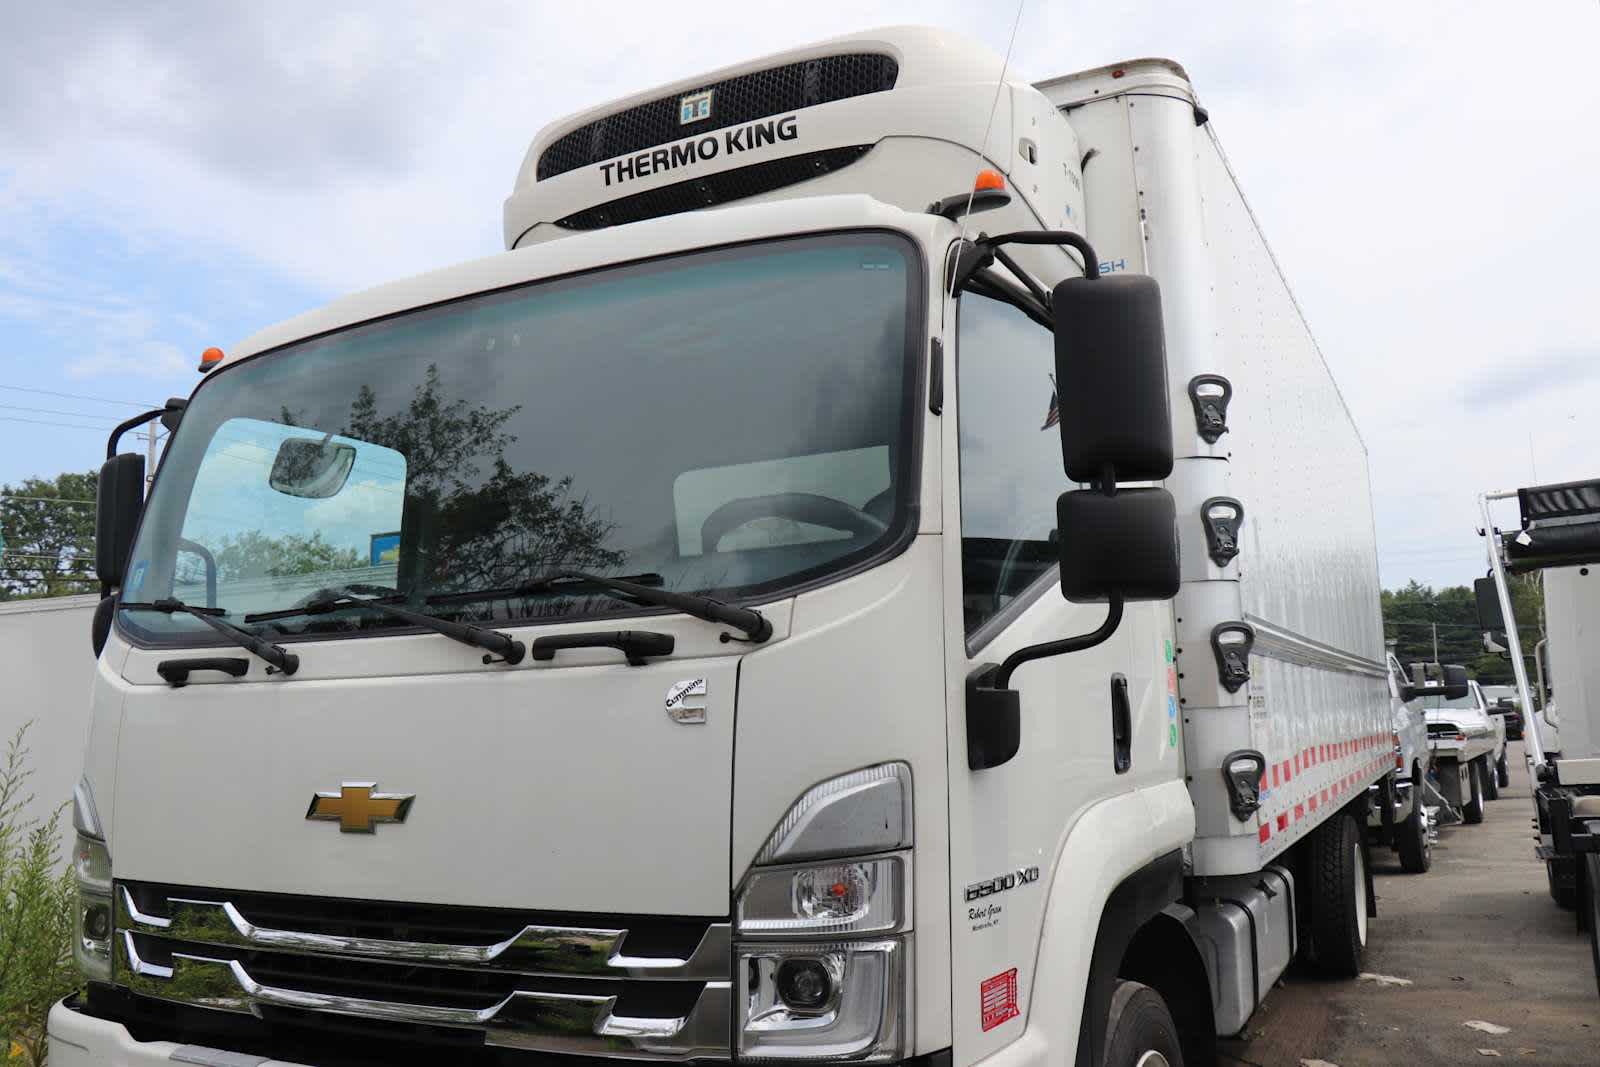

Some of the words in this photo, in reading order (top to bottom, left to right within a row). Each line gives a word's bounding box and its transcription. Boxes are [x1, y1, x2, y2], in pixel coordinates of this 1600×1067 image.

[599, 136, 719, 187] THERMO
[724, 115, 799, 155] KING
[666, 679, 703, 707] Cummins
[963, 873, 1014, 903] 6500
